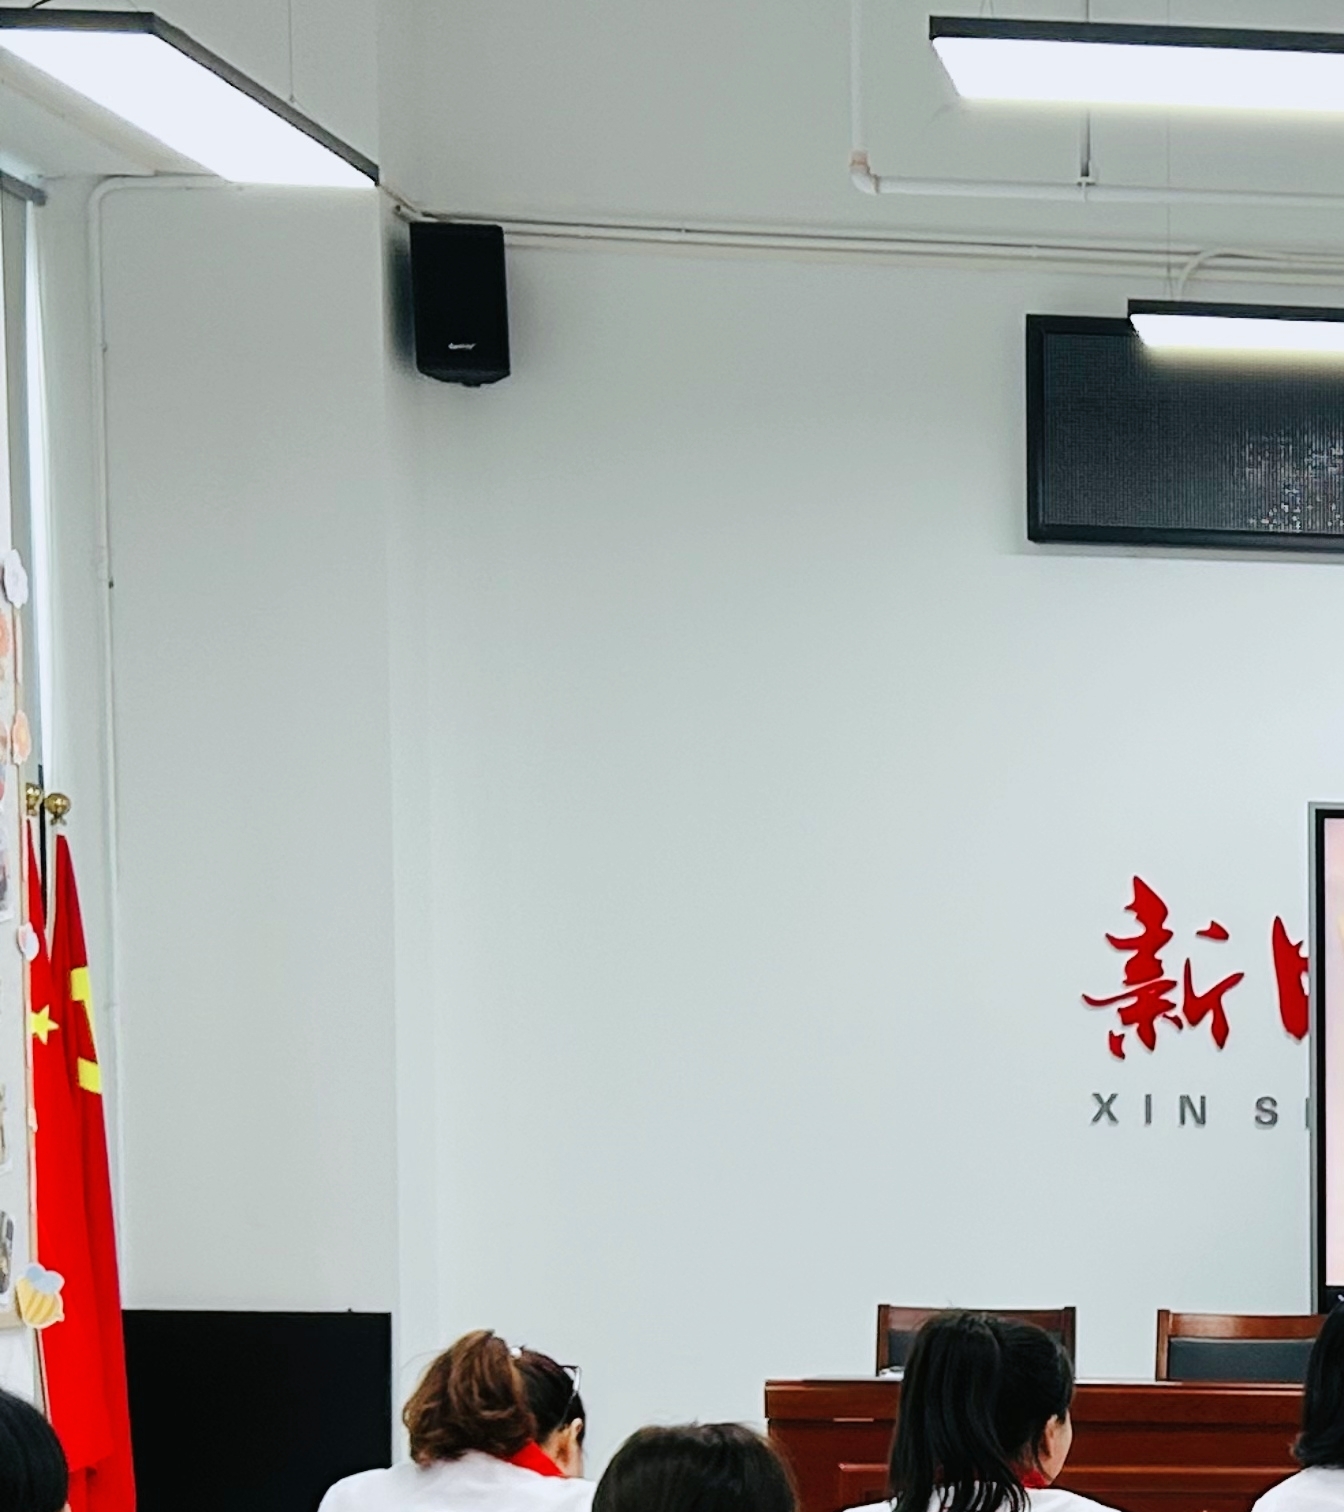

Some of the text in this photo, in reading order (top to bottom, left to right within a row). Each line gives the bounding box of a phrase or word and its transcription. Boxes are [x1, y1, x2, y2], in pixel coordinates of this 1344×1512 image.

[1081, 875, 1310, 1060] 新
[1090, 1092, 1311, 1130] XIN S
